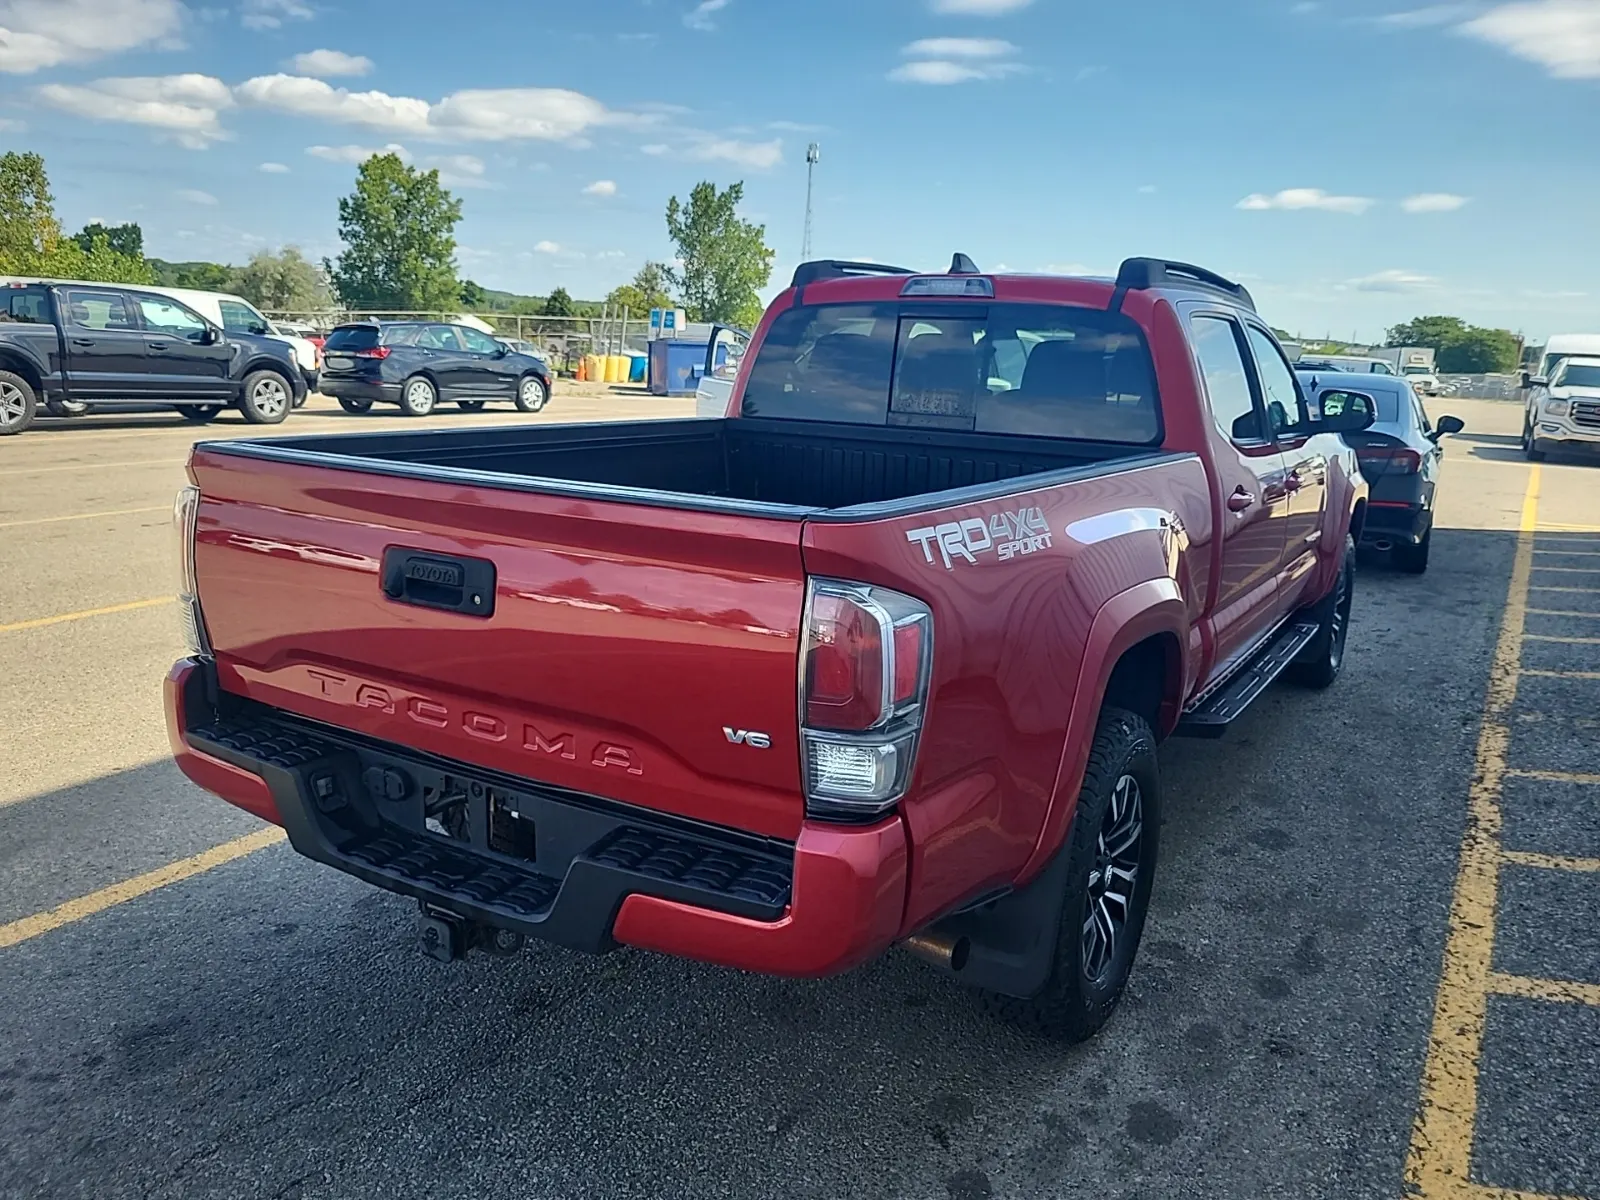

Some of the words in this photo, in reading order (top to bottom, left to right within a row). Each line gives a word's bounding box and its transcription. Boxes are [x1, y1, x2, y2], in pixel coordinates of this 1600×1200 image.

[905, 517, 992, 570] TRD
[997, 534, 1052, 562] SPORT
[410, 564, 457, 584] TOYOTA
[306, 668, 643, 776] TACOMA
[722, 726, 770, 749] V6
